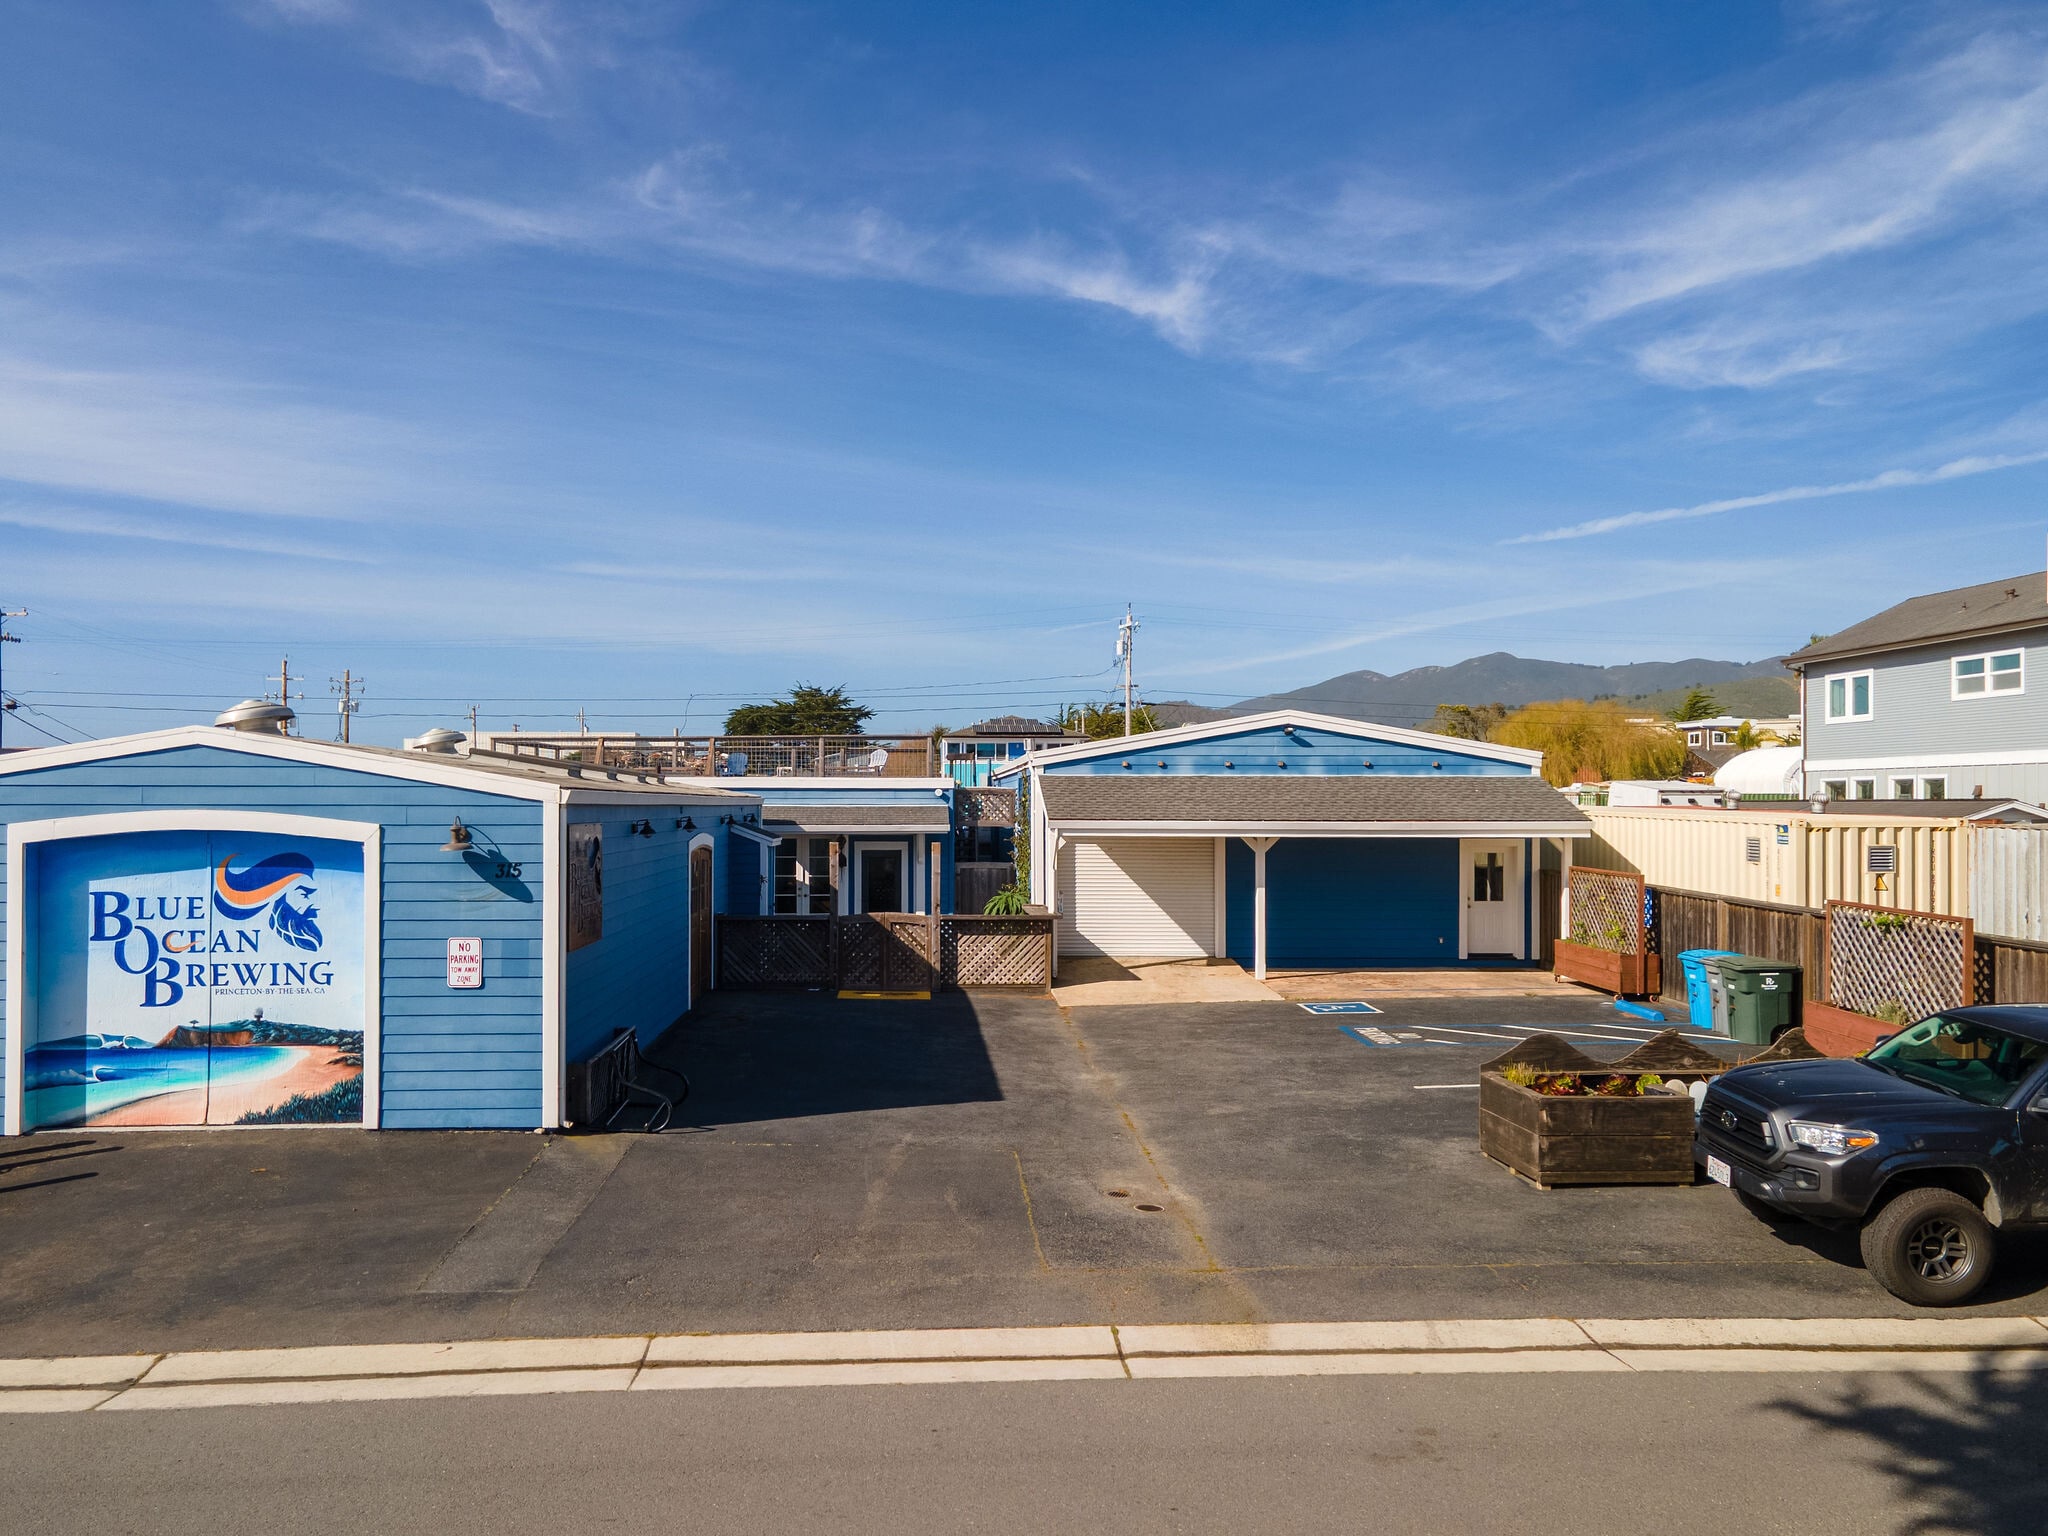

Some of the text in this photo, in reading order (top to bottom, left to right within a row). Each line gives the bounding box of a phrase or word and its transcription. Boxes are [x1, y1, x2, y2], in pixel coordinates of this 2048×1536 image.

[495, 862, 522, 879] 315
[458, 943, 471, 952] NO
[450, 955, 478, 964] PARKING
